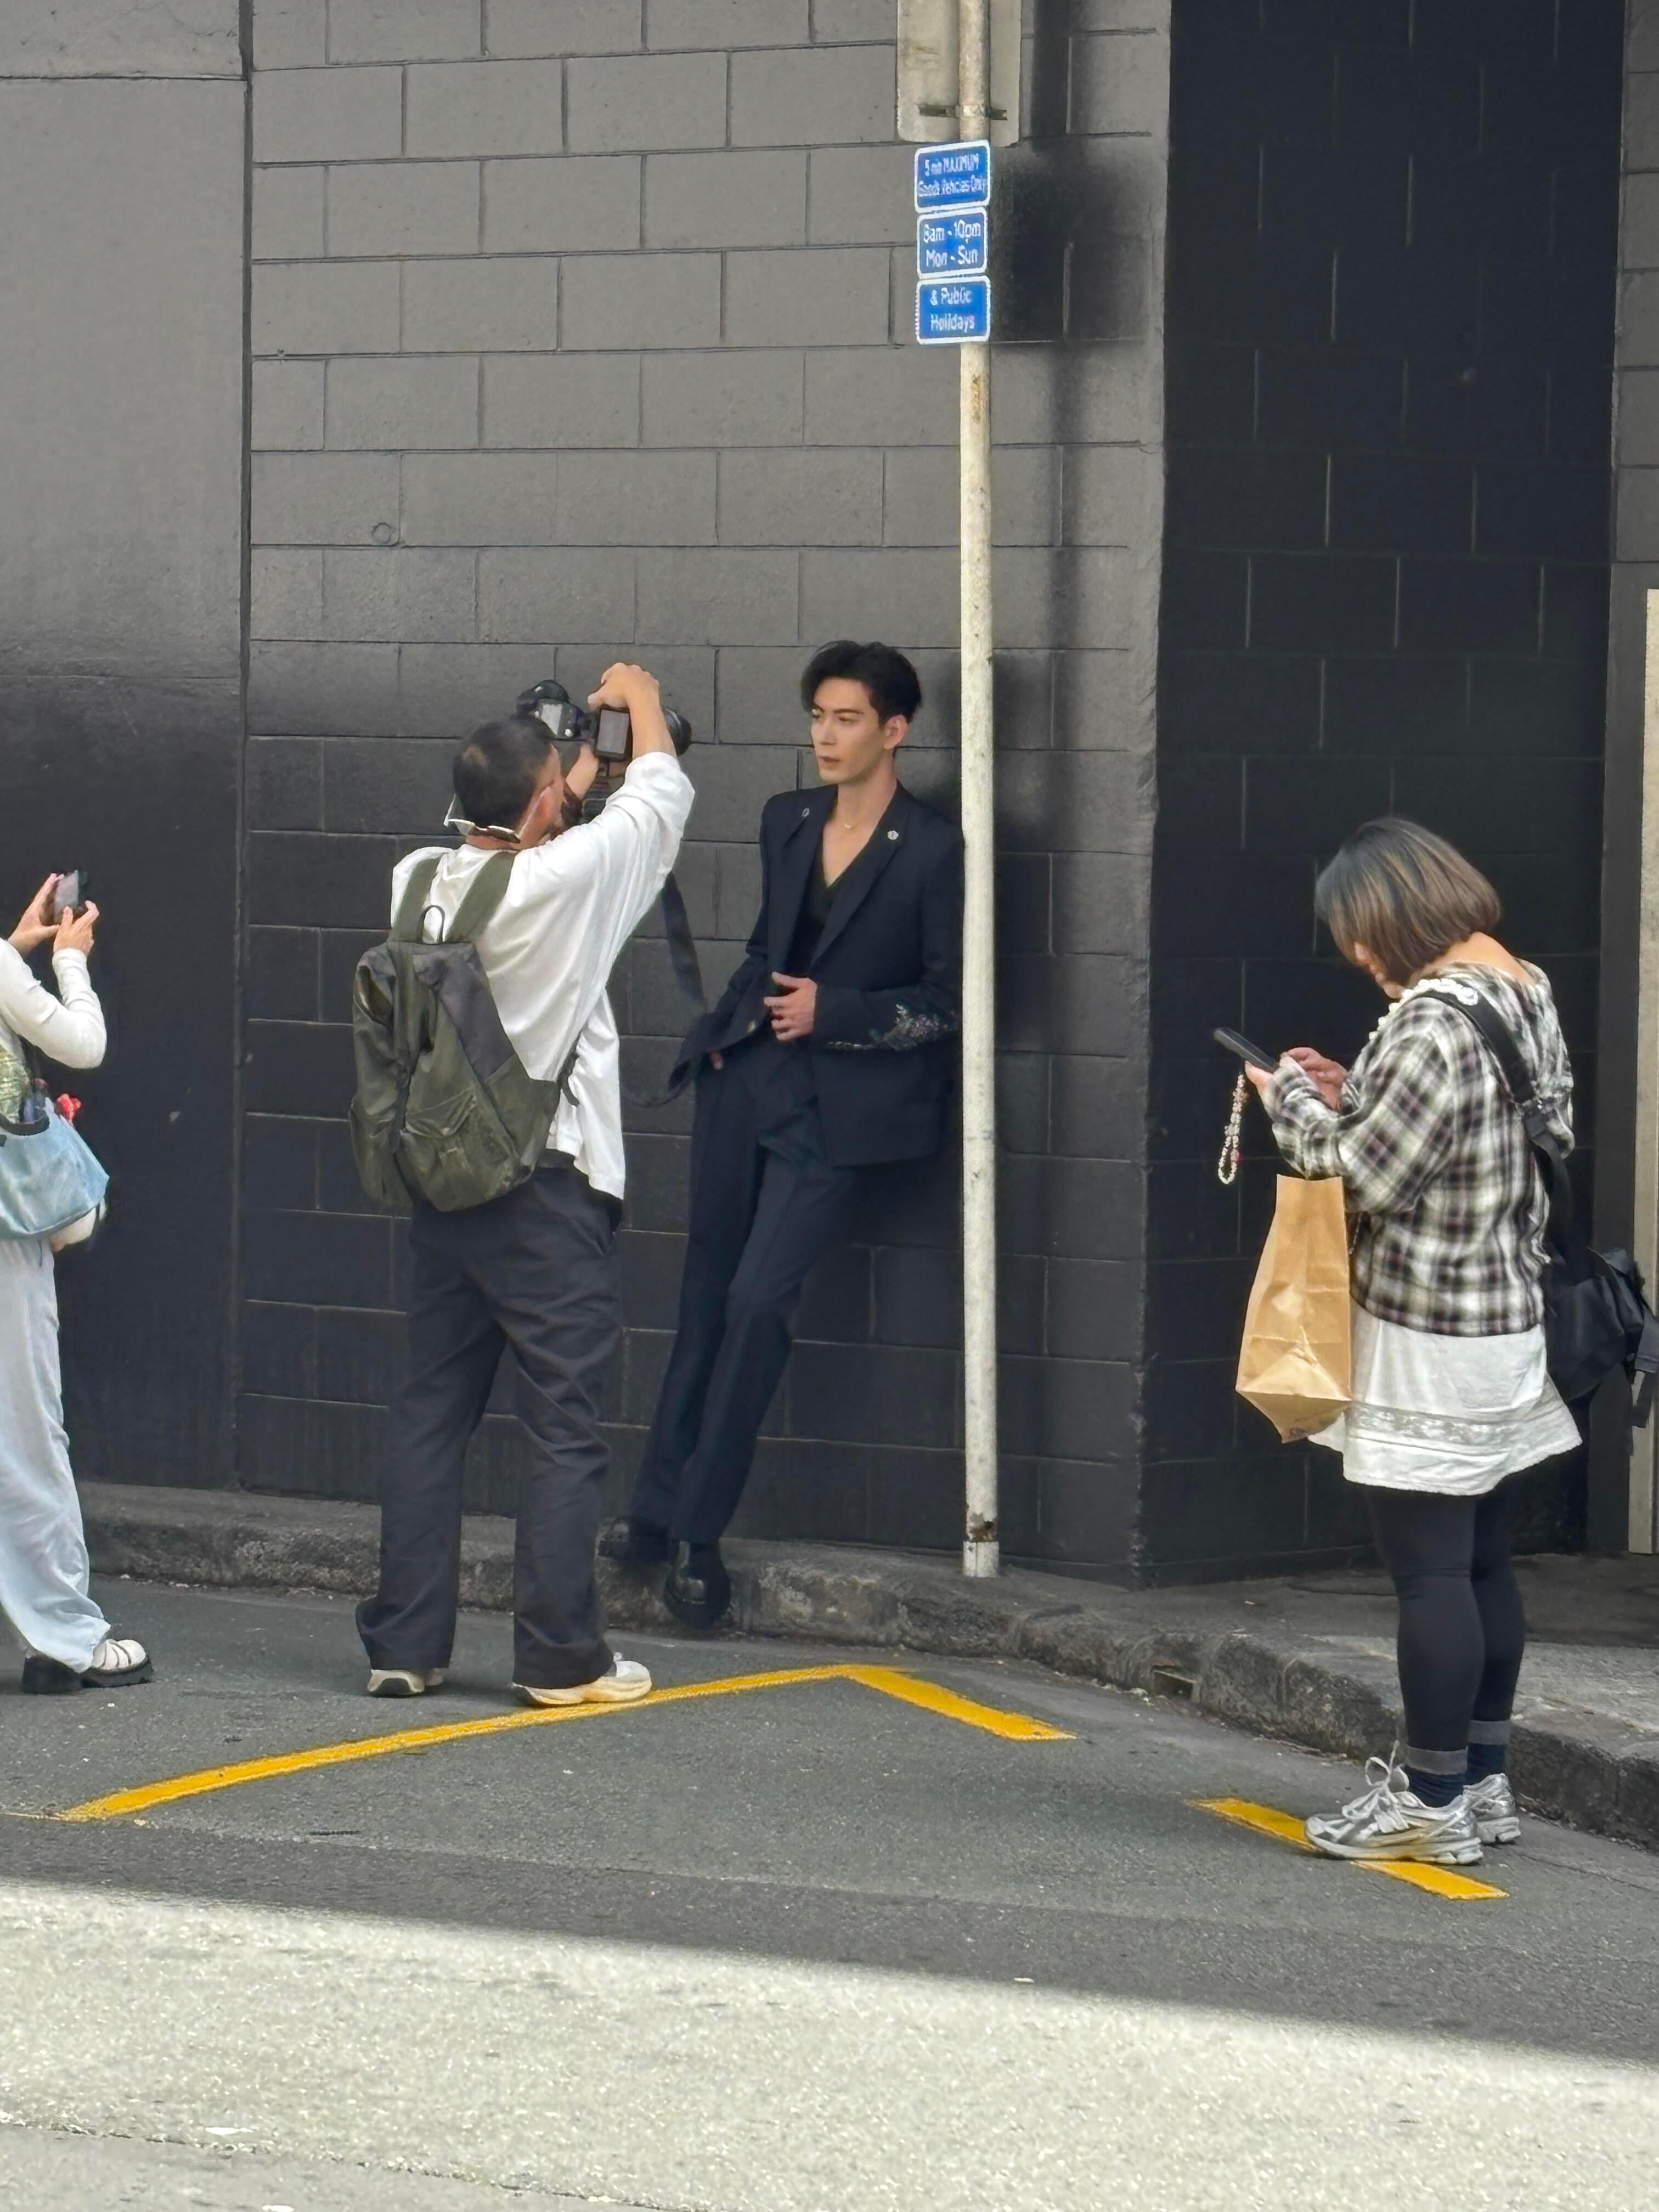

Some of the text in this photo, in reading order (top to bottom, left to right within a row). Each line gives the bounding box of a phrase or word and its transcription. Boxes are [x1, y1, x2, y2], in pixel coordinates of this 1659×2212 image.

[953, 219, 981, 244] 10pm
[926, 249, 947, 267] Mon
[958, 245, 978, 265] Sun
[930, 286, 972, 306] & Public
[930, 313, 975, 332] Holidays
